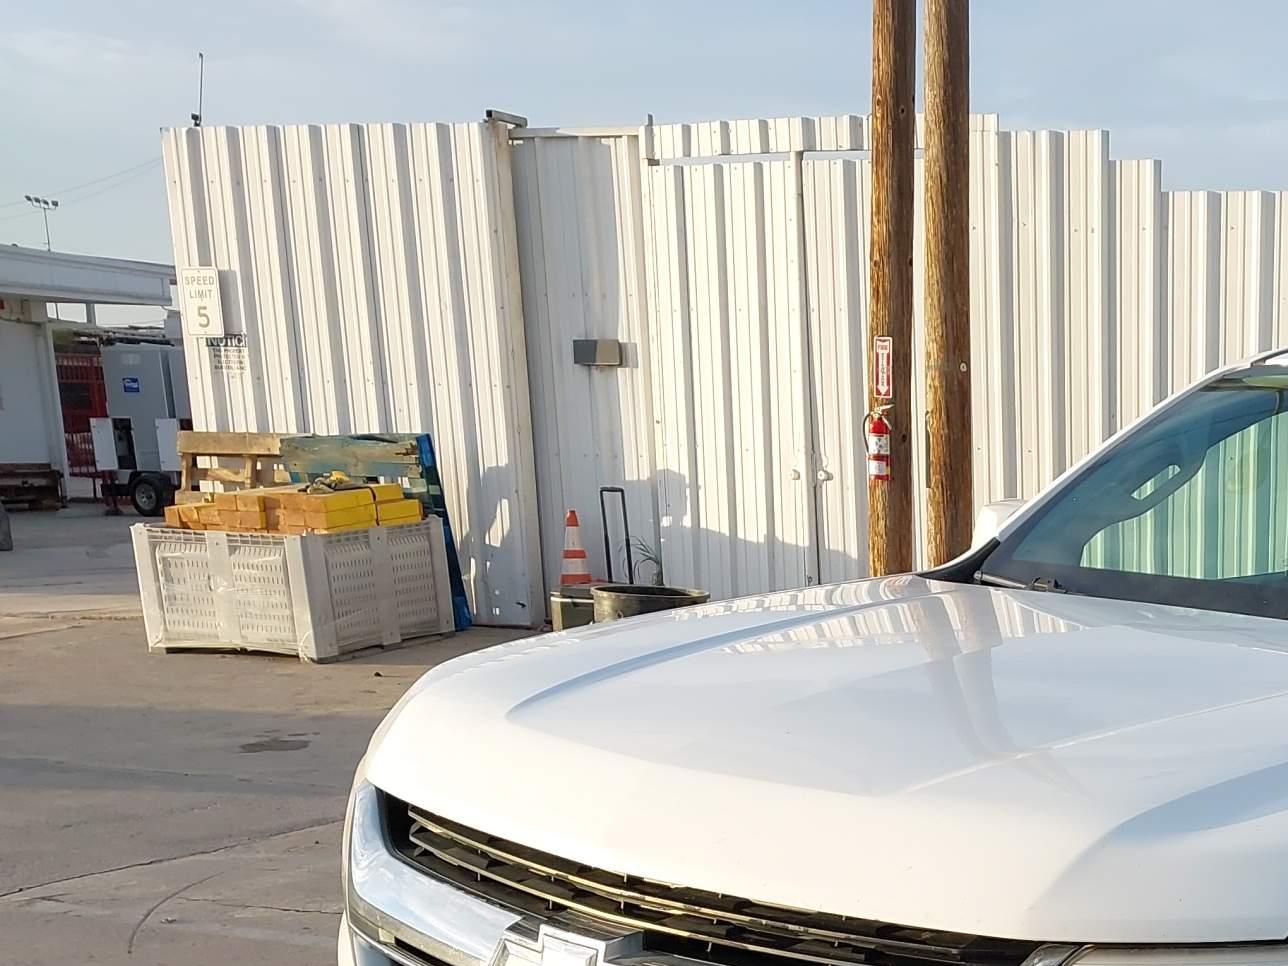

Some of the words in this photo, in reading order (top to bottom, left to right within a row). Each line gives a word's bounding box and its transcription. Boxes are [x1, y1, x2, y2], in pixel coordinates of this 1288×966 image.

[184, 276, 215, 286] SPEED
[189, 290, 212, 299] LIMIT
[197, 306, 210, 328] 5
